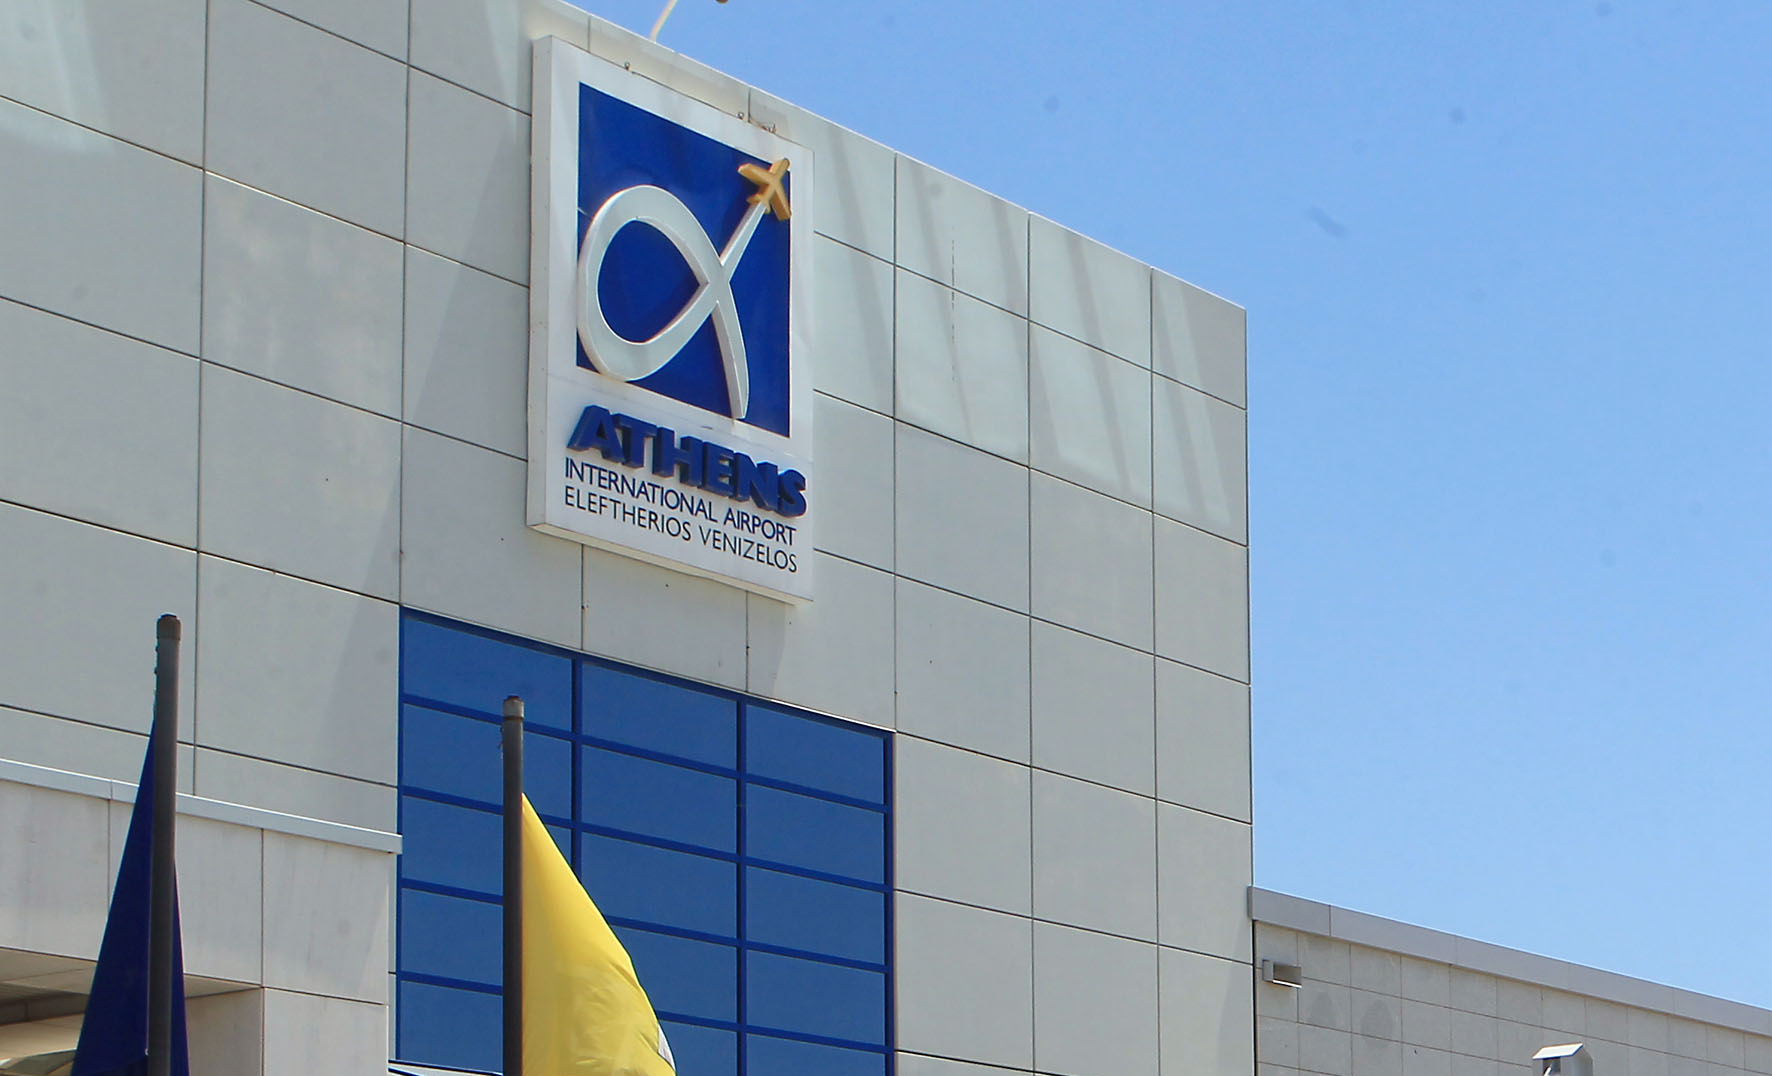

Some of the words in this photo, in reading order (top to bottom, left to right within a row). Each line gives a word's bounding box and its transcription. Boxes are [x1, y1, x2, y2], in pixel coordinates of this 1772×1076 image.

[564, 457, 718, 522] INTERNATIONAL
[724, 507, 797, 546] AIRPORT
[567, 405, 807, 517] ATHENS
[564, 486, 692, 541] ELEFTHERIOS
[699, 525, 798, 574] VENIZELOS
